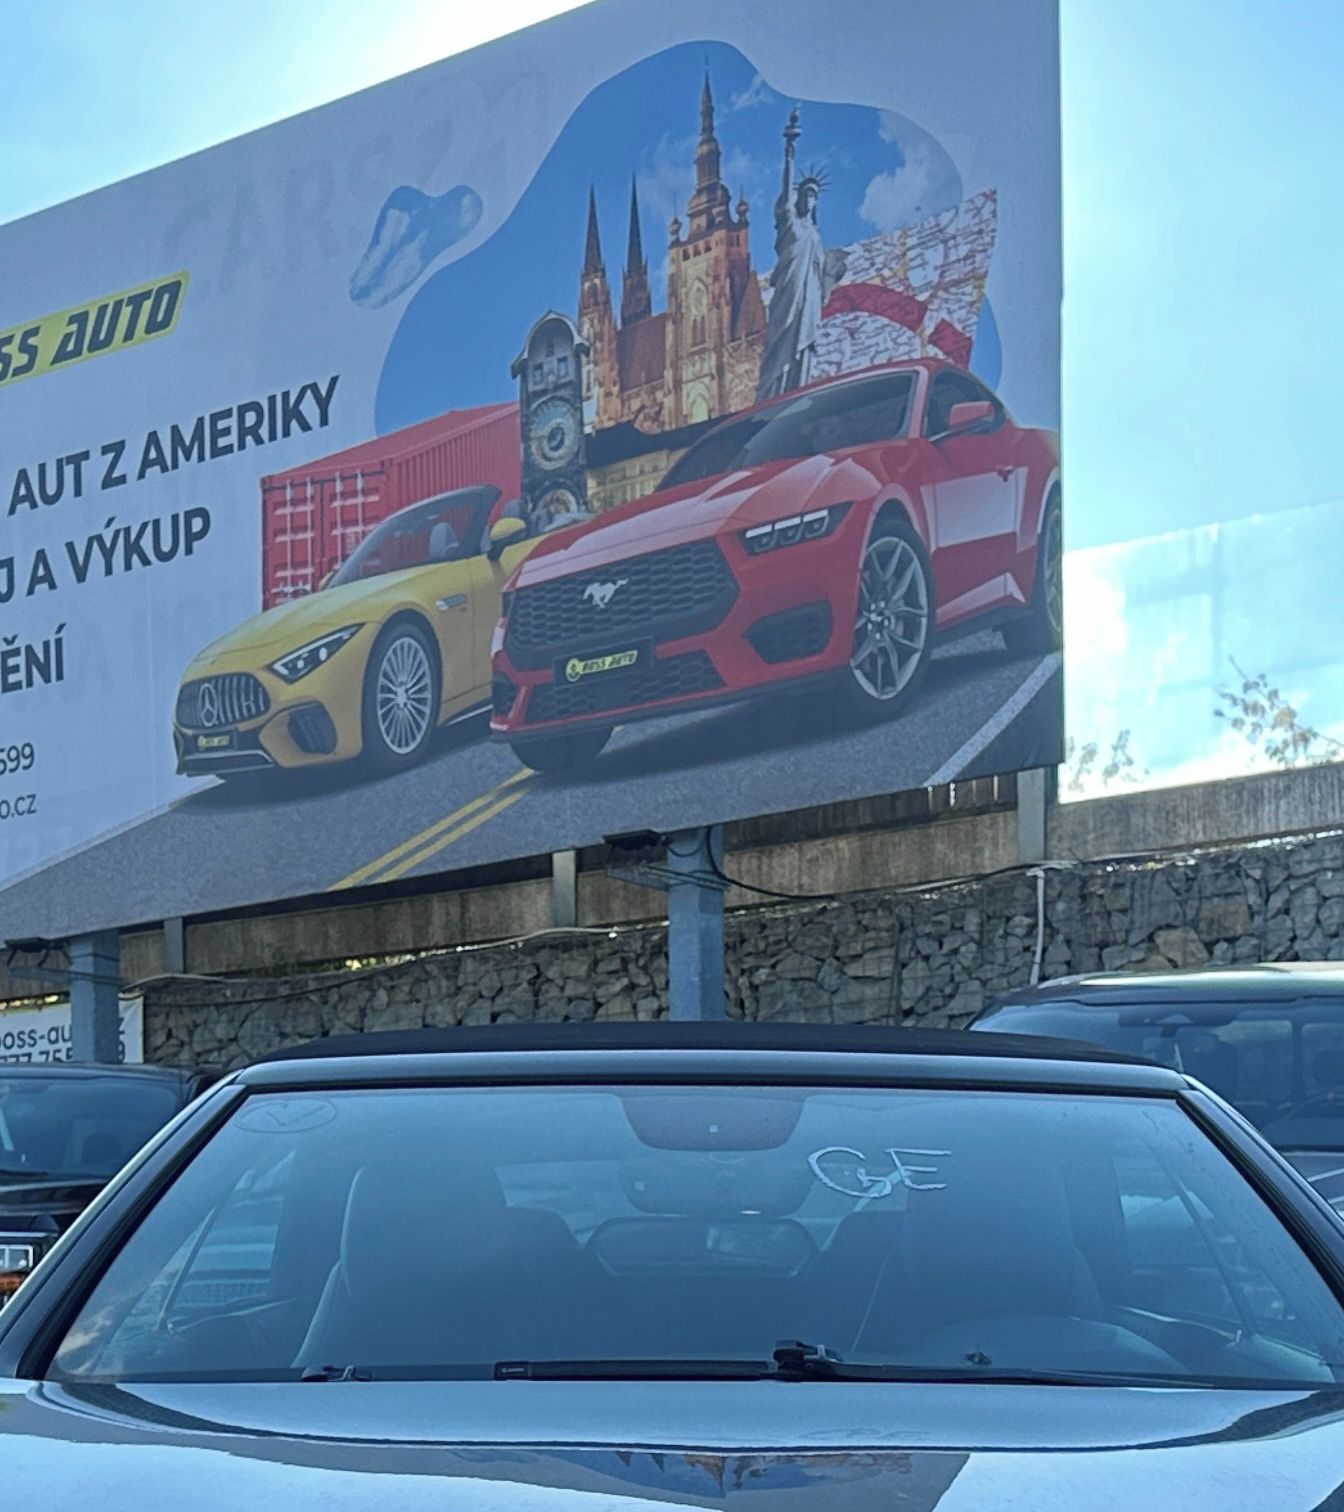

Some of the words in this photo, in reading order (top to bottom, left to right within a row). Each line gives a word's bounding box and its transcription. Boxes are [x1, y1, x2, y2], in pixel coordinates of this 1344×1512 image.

[49, 278, 184, 368] AUTO
[7, 449, 92, 517] AUT
[100, 439, 127, 491] Z
[136, 374, 341, 481] AMERIKY
[26, 548, 57, 596] A
[64, 506, 212, 586] VÝKUP
